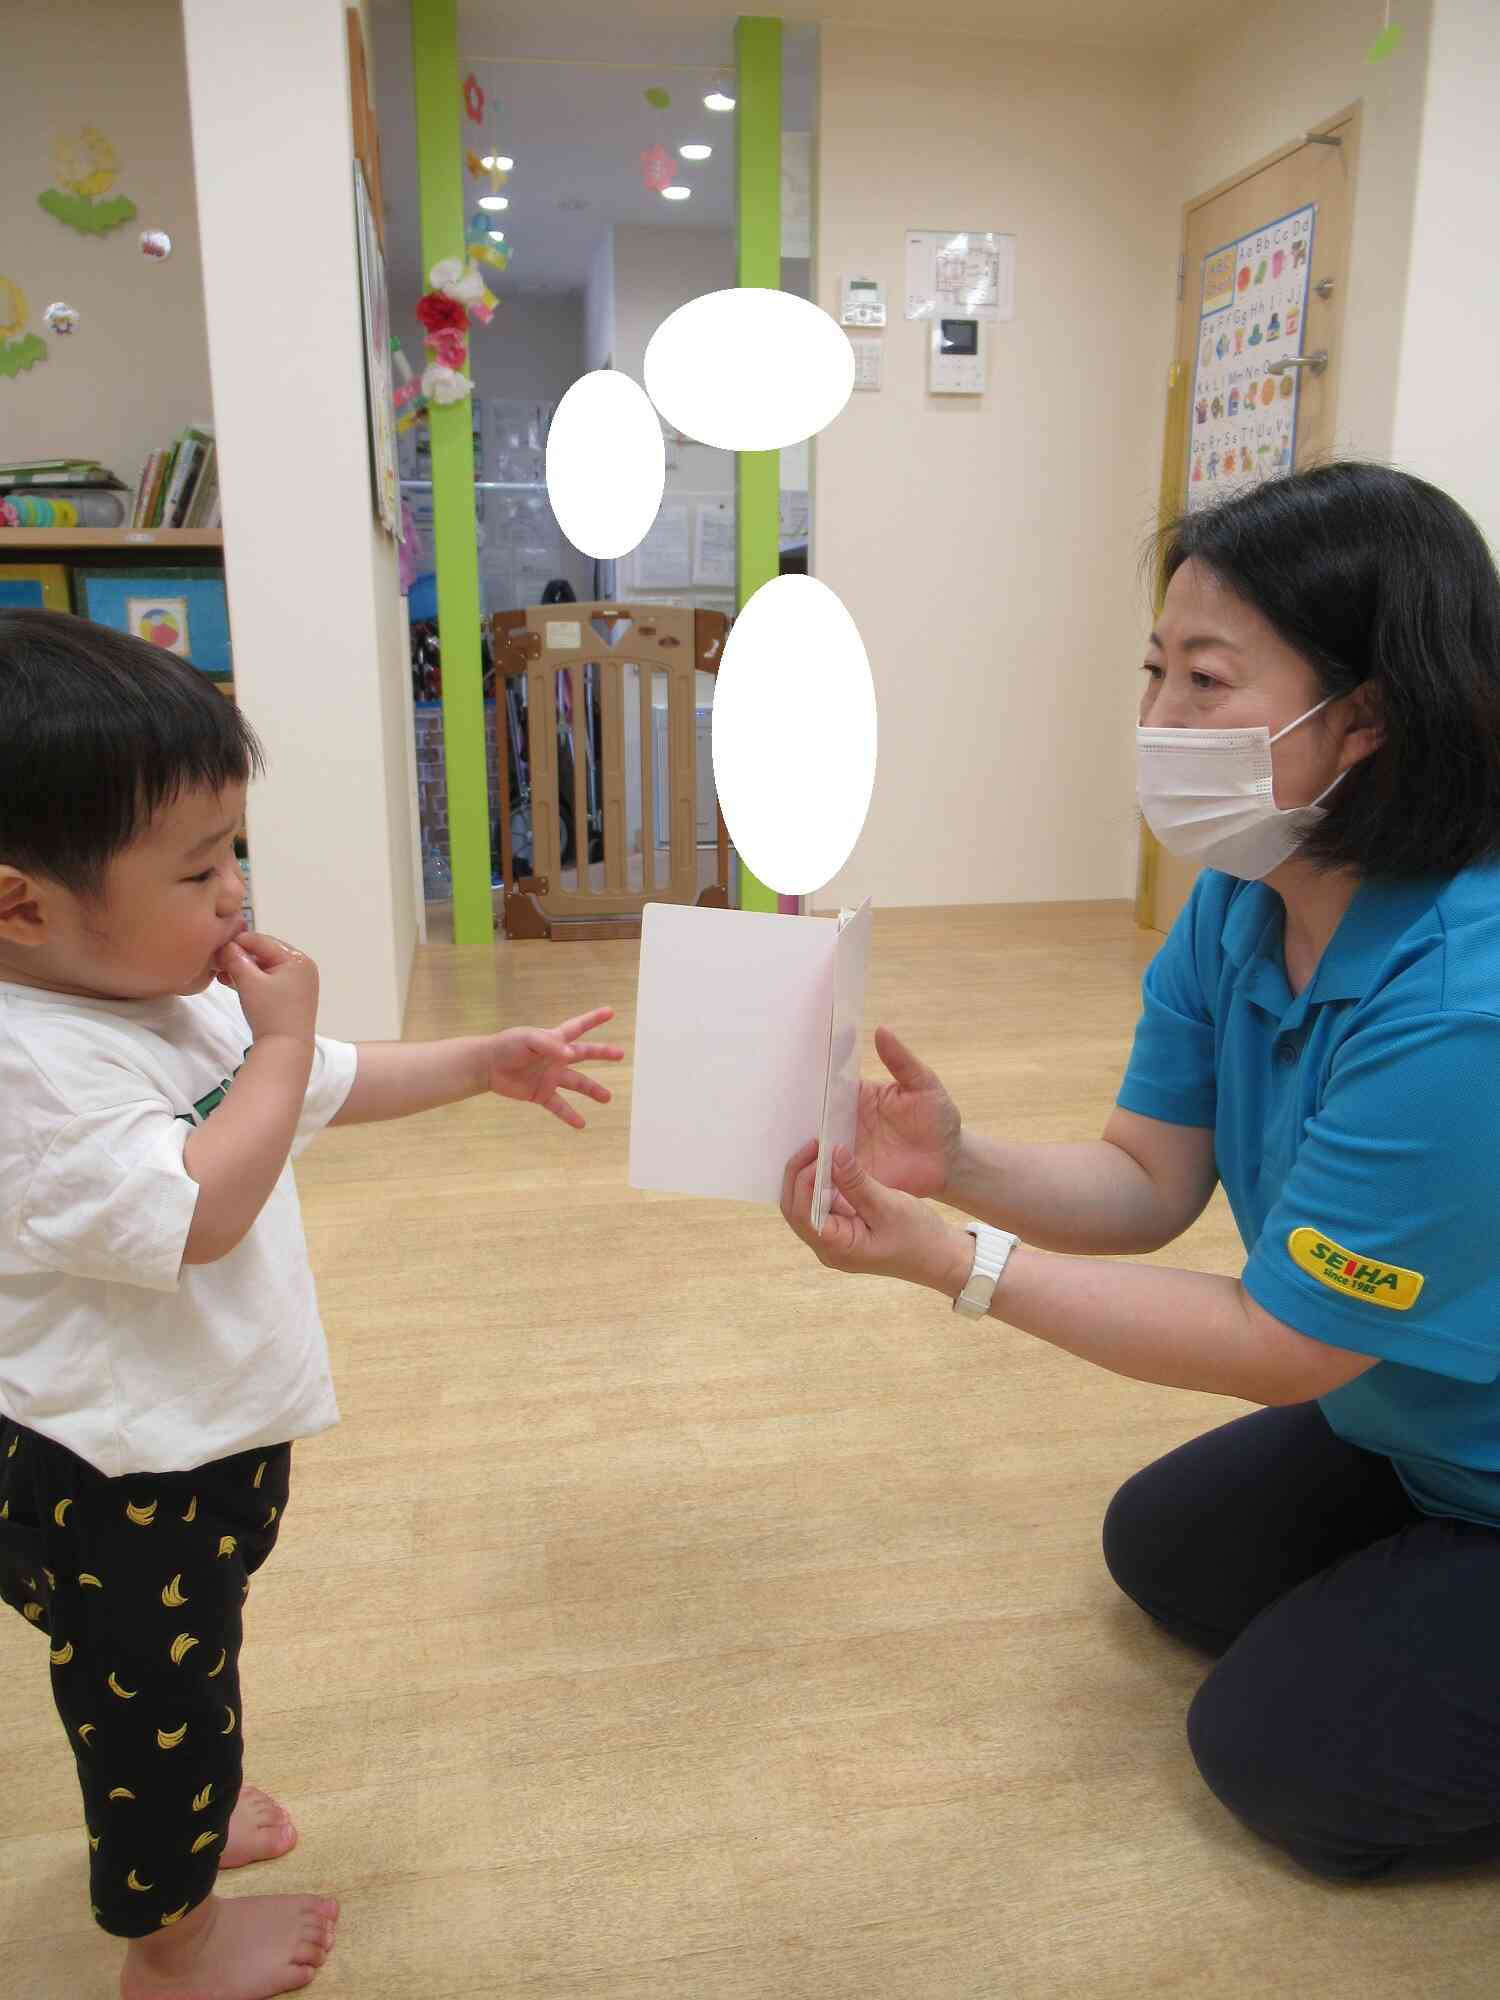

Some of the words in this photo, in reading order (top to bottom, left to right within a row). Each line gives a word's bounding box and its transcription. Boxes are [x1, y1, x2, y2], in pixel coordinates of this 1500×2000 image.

[1309, 1242, 1398, 1290] SEIHA
[1323, 1267, 1349, 1285] since
[1351, 1279, 1378, 1294] 1985
